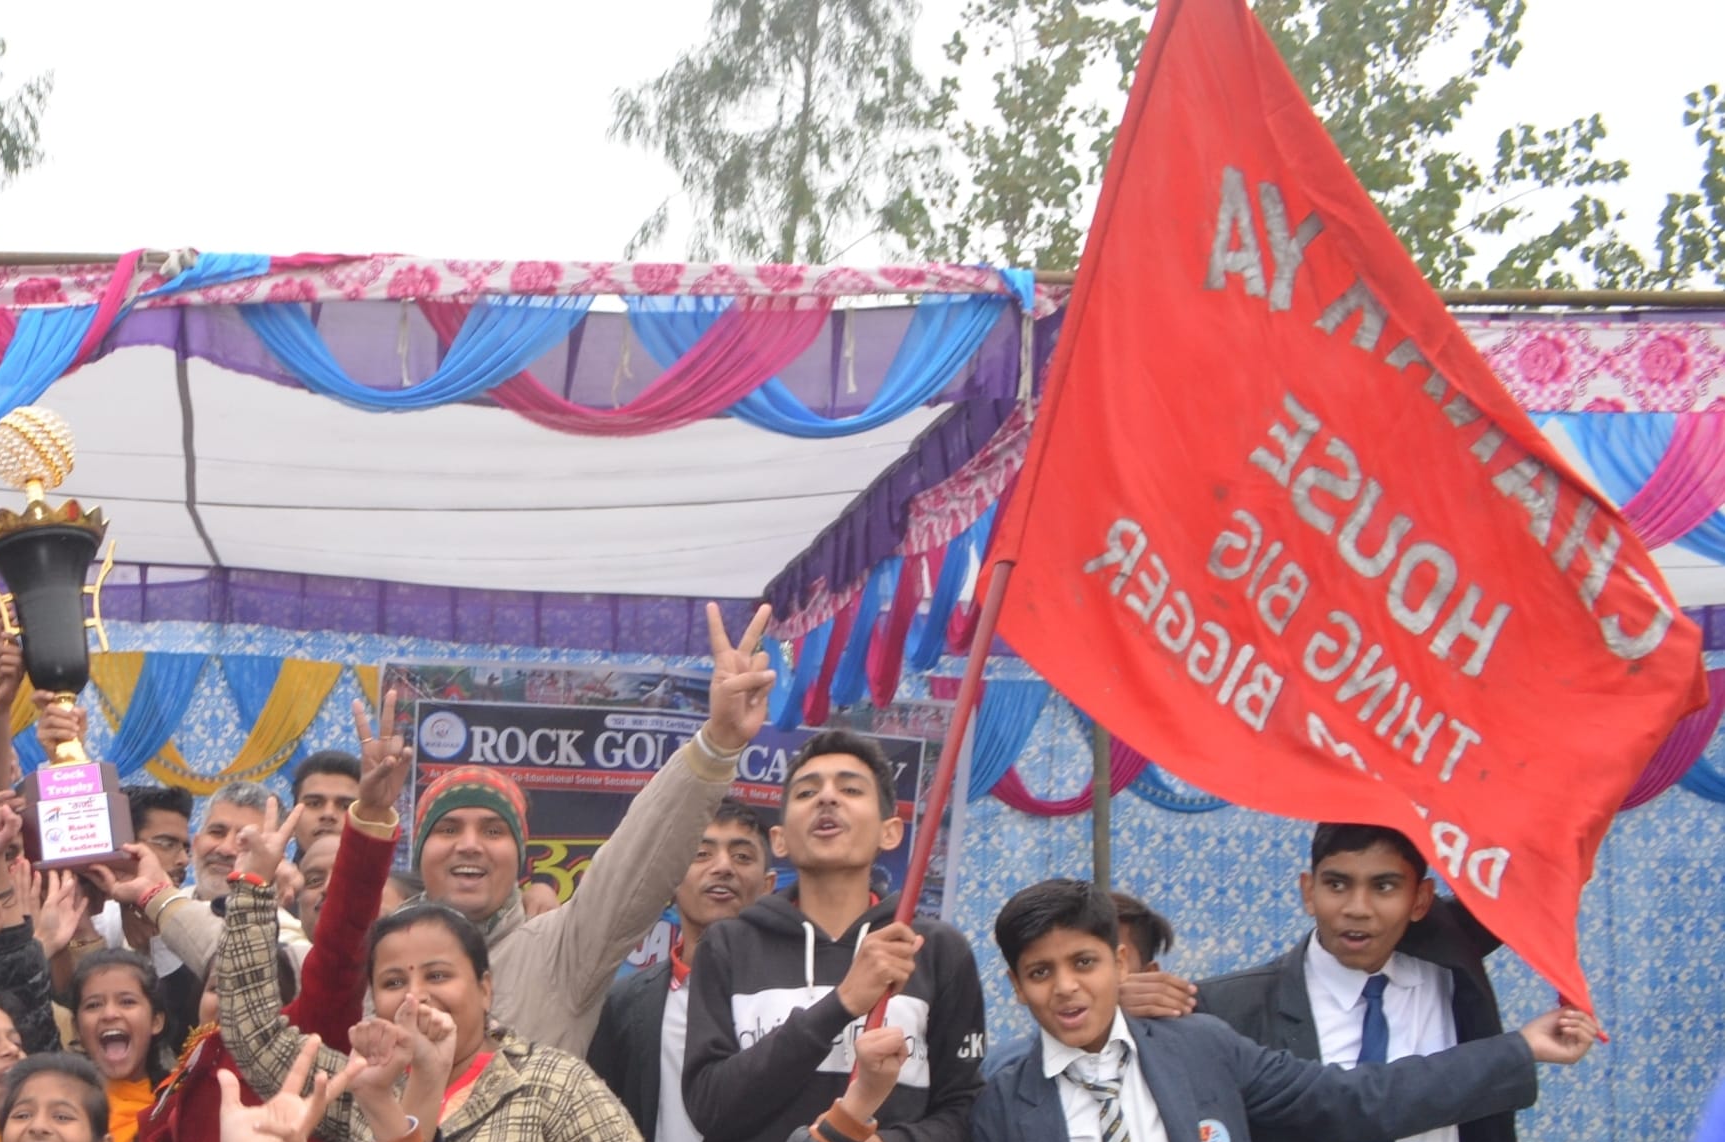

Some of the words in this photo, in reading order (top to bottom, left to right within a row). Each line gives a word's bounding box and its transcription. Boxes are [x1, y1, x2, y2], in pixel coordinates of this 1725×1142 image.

[469, 726, 585, 766] ROCK
[594, 731, 691, 770] GOL
[45, 782, 94, 796] Trophy
